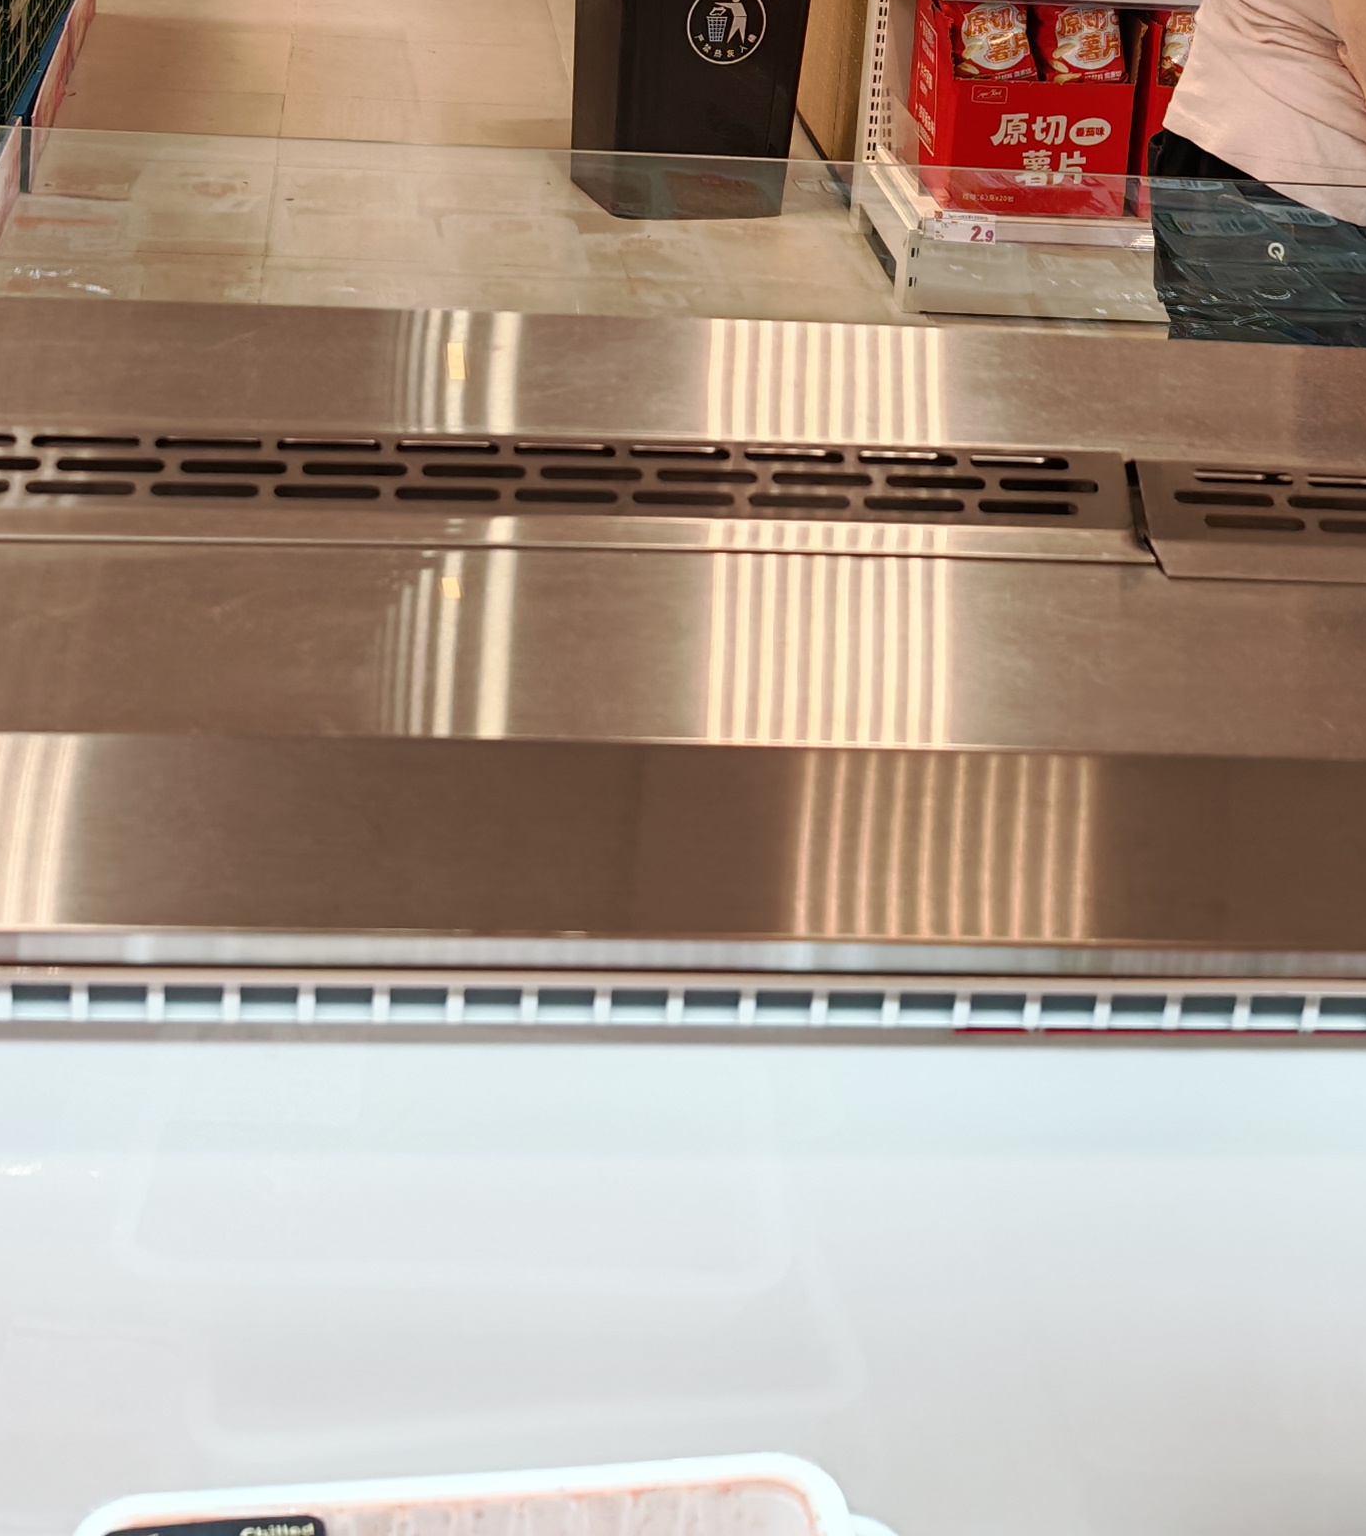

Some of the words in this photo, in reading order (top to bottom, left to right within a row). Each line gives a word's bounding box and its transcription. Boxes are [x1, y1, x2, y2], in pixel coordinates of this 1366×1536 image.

[963, 9, 1013, 37] 原切
[1057, 9, 1108, 37] 原切
[985, 33, 1030, 64] 薯片
[1076, 33, 1121, 62] 薯片
[990, 112, 1067, 146] 原切
[1075, 125, 1107, 138] 番茄味
[1014, 149, 1087, 186] 薯片
[970, 224, 994, 243] 2.9
